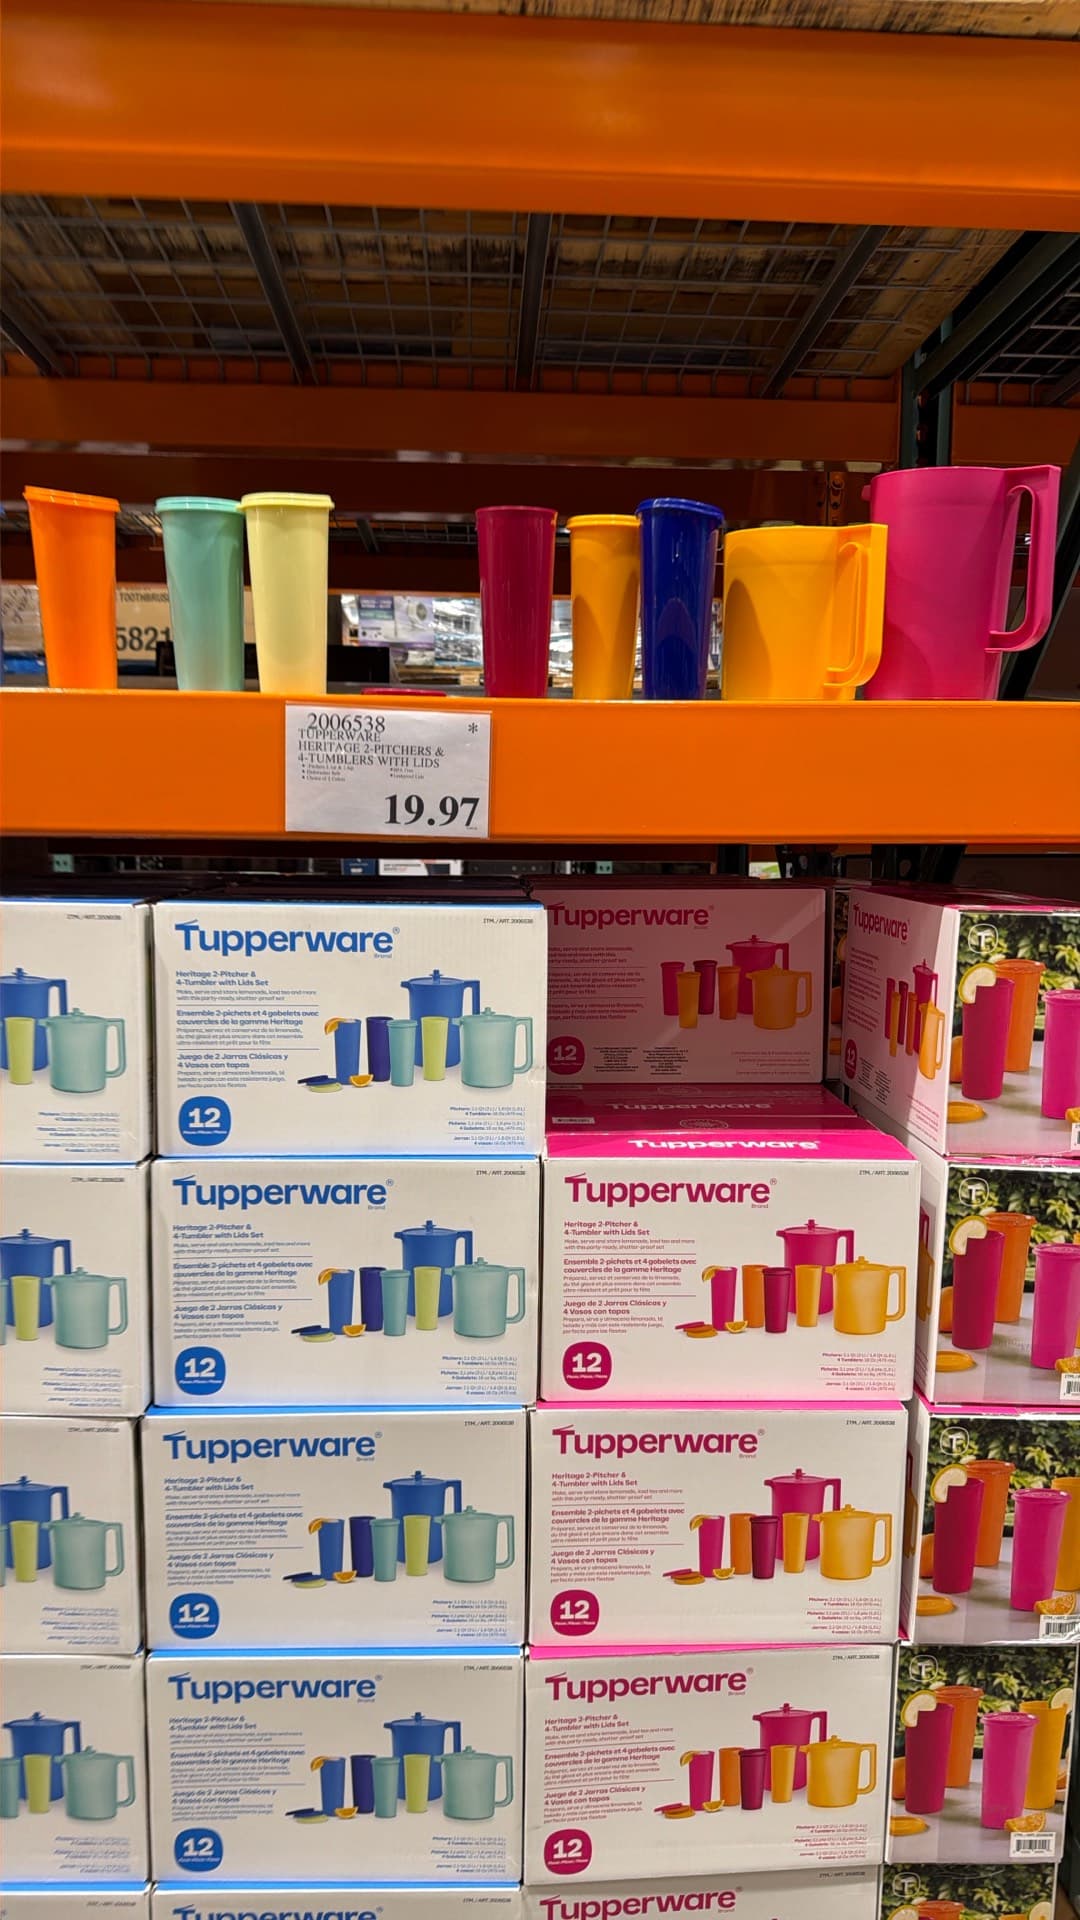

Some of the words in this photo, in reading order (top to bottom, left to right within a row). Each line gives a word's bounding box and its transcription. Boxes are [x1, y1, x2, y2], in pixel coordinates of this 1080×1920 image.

[120, 592, 169, 602] TOOTHBRUS
[307, 712, 385, 733] 2006538
[298, 728, 381, 742] TUPPERWARE
[298, 741, 360, 754] HERITAGE
[364, 744, 432, 756] 2-PITCHERS
[435, 747, 445, 756] &
[298, 753, 374, 766] 4-TUMBLERS
[378, 755, 409, 767] WITH
[413, 757, 440, 768] LIDS
[385, 794, 480, 827] 19.97
[547, 902, 709, 929] Tupperware
[853, 903, 908, 940] Tupperware
[175, 919, 393, 957] Tupperware
[554, 1045, 576, 1060] 12
[189, 1108, 221, 1128] 12
[627, 1139, 818, 1150] Tupperware
[172, 1174, 387, 1210] Tupperware
[564, 1172, 770, 1207] Tupperware
[600, 1258, 633, 1266] 2-pichets
[563, 1300, 586, 1308] Juego
[185, 1358, 216, 1378] 12
[572, 1353, 602, 1373] 12
[162, 1430, 376, 1464] Tupperware
[553, 1424, 758, 1459] Tupperware
[178, 1603, 210, 1623] 12
[560, 1600, 589, 1619] 12
[168, 1672, 376, 1704] Tupperware
[545, 1672, 747, 1703] Tupperware
[183, 1837, 214, 1857] 12
[553, 1838, 582, 1859] 12
